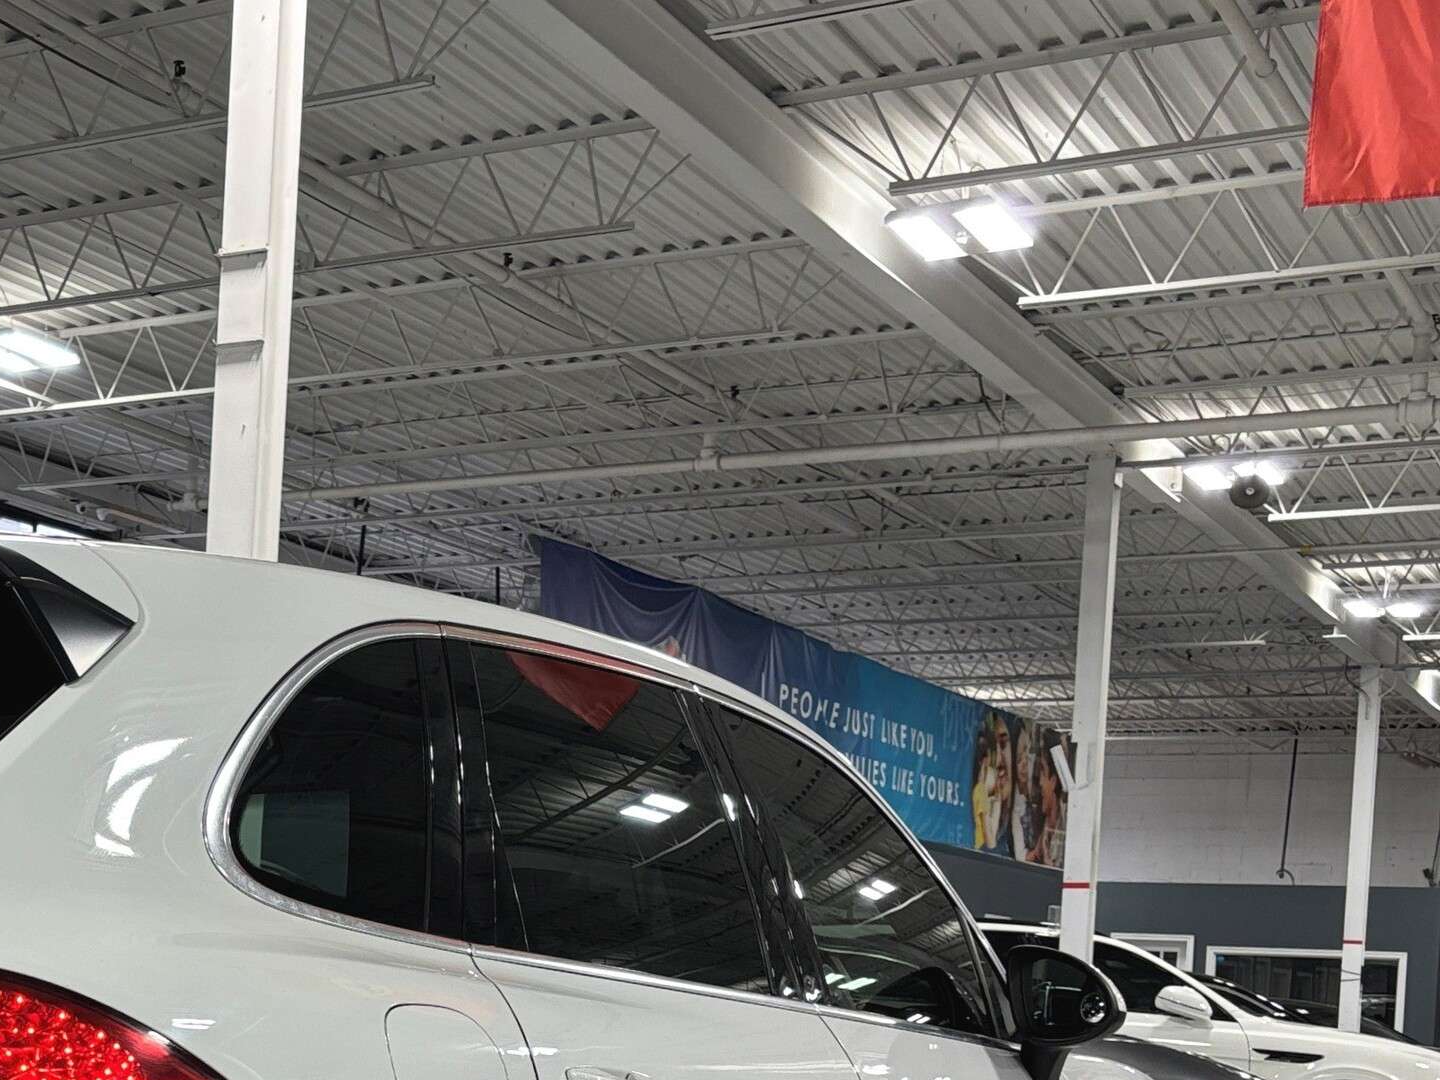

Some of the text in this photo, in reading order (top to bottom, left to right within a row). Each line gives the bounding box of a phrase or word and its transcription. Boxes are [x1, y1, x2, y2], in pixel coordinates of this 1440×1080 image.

[843, 707, 875, 740] JUST
[881, 717, 907, 748] LIKE
[891, 766, 913, 795] LIKE
[920, 773, 964, 806] YOURS.
